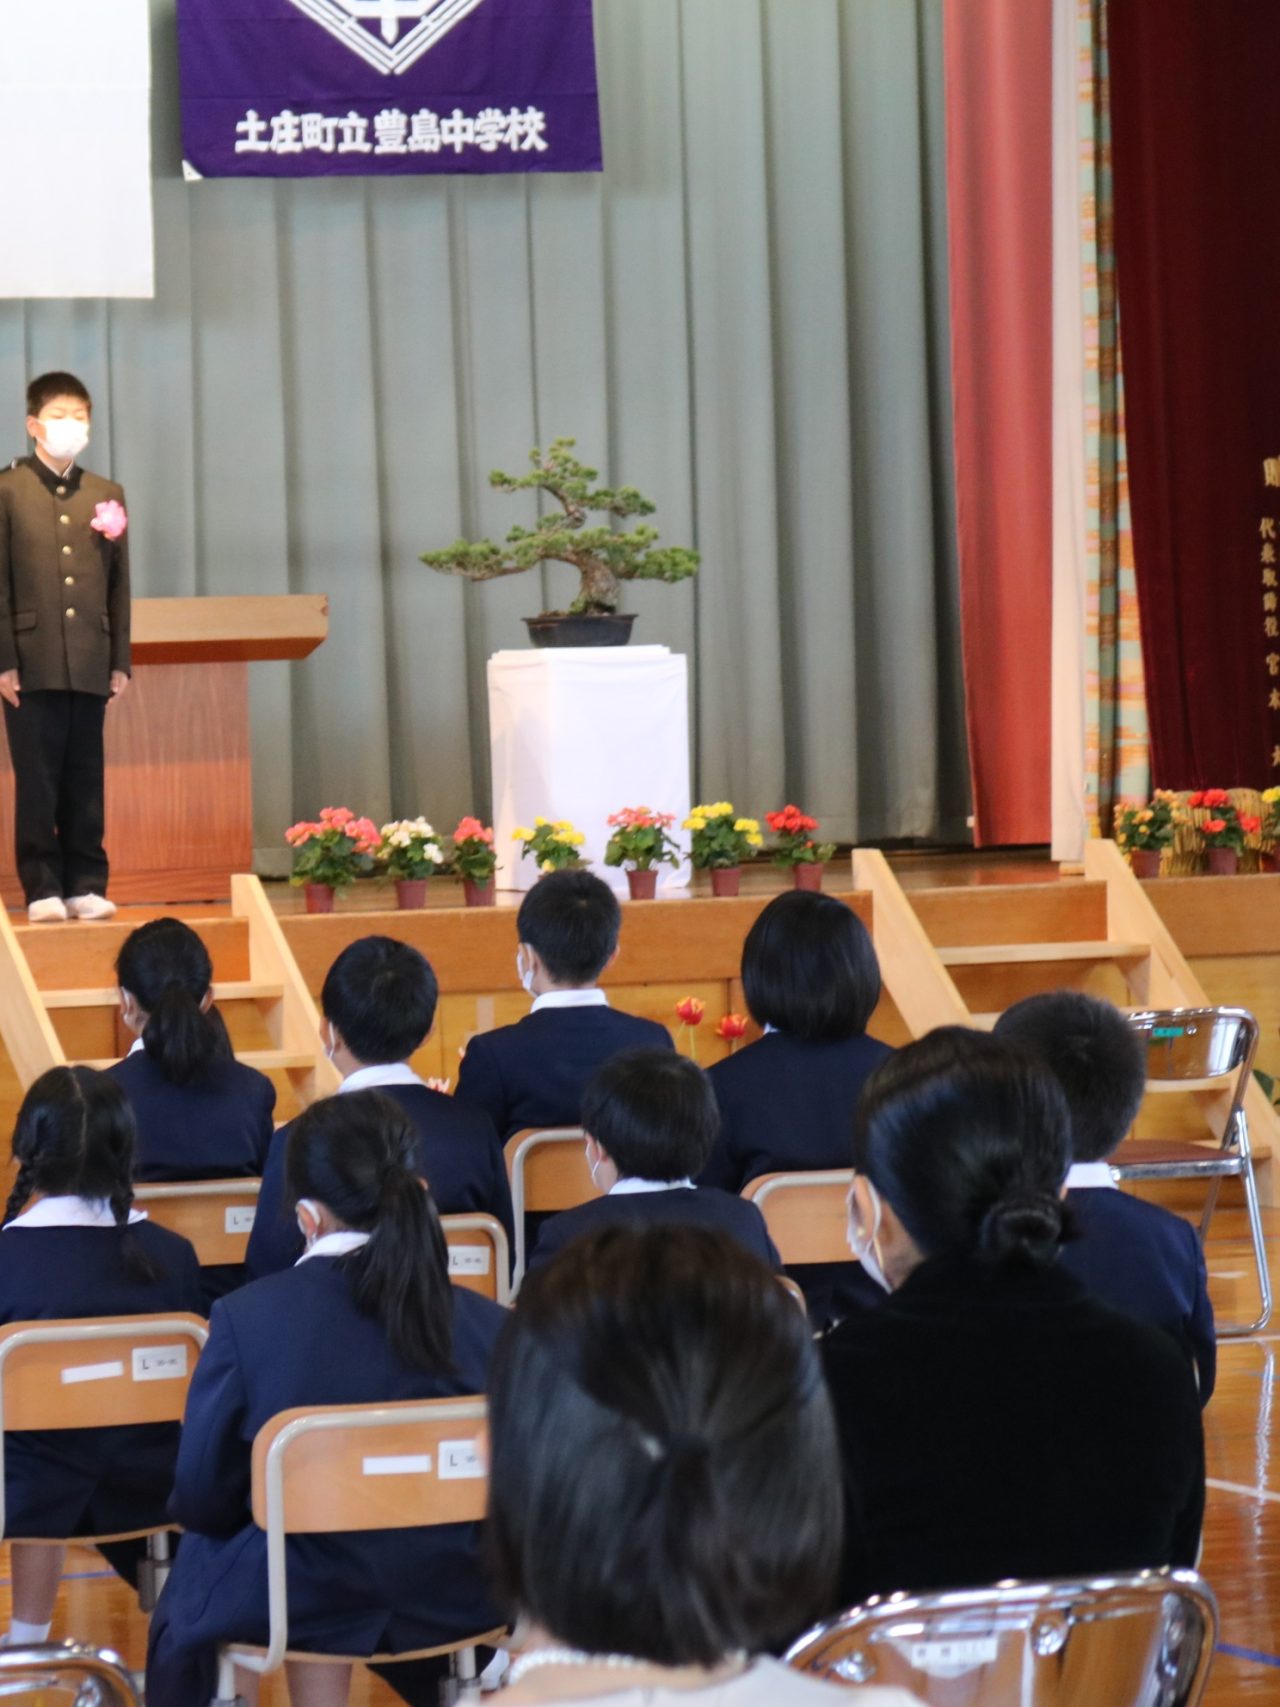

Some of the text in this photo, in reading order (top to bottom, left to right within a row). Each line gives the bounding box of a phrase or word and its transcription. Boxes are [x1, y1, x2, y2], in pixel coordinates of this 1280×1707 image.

[235, 106, 548, 154] 土庄町立豊島中学校
[142, 1359, 150, 1370] L
[450, 1454, 458, 1467] L
